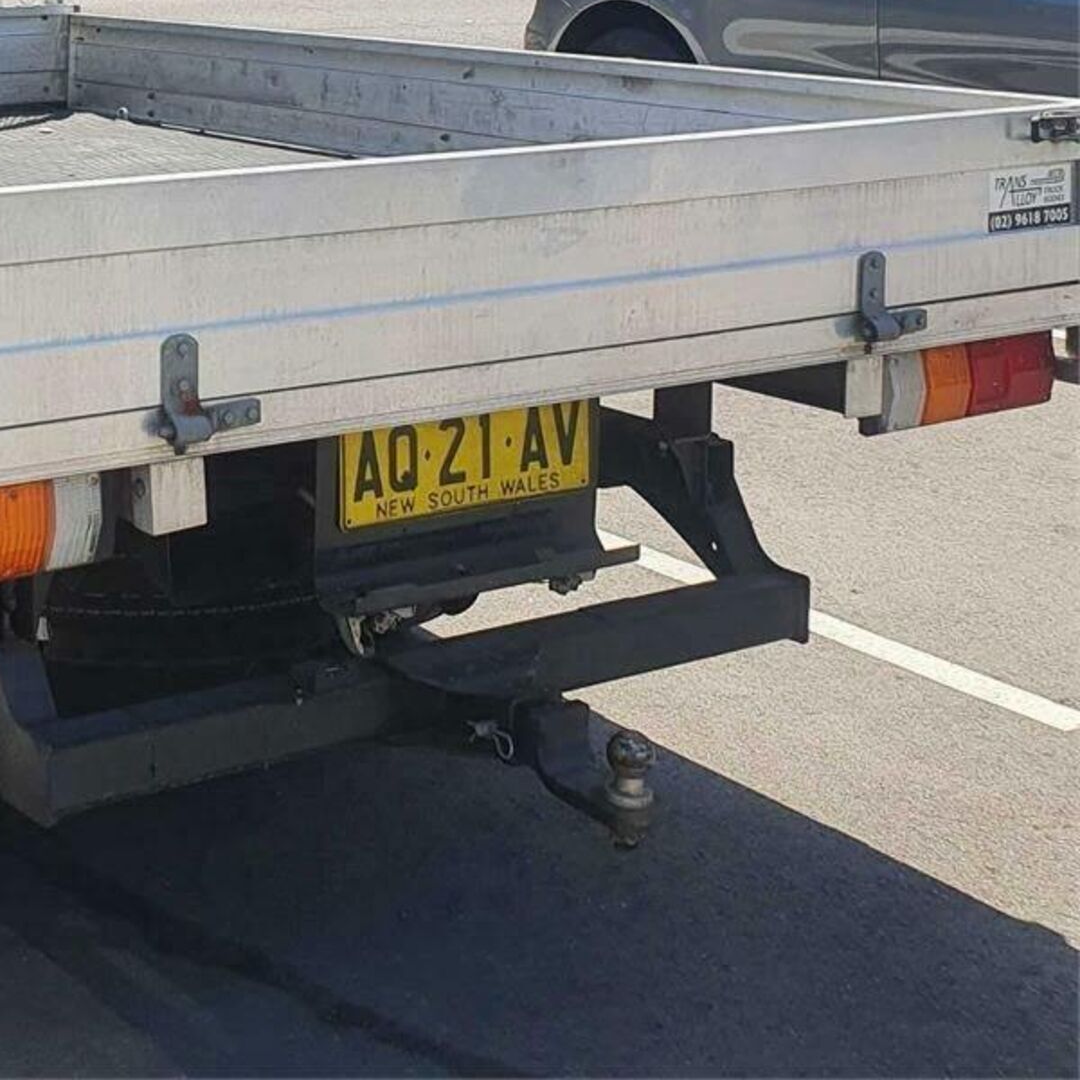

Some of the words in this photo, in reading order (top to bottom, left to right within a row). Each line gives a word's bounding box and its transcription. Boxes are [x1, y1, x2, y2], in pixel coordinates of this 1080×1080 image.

[991, 214, 1013, 232] (02)
[1015, 210, 1041, 227] 9618
[1043, 206, 1069, 224] 7005
[376, 496, 416, 519] NEW
[428, 483, 489, 511] SOUTH
[500, 472, 561, 496] WALES
